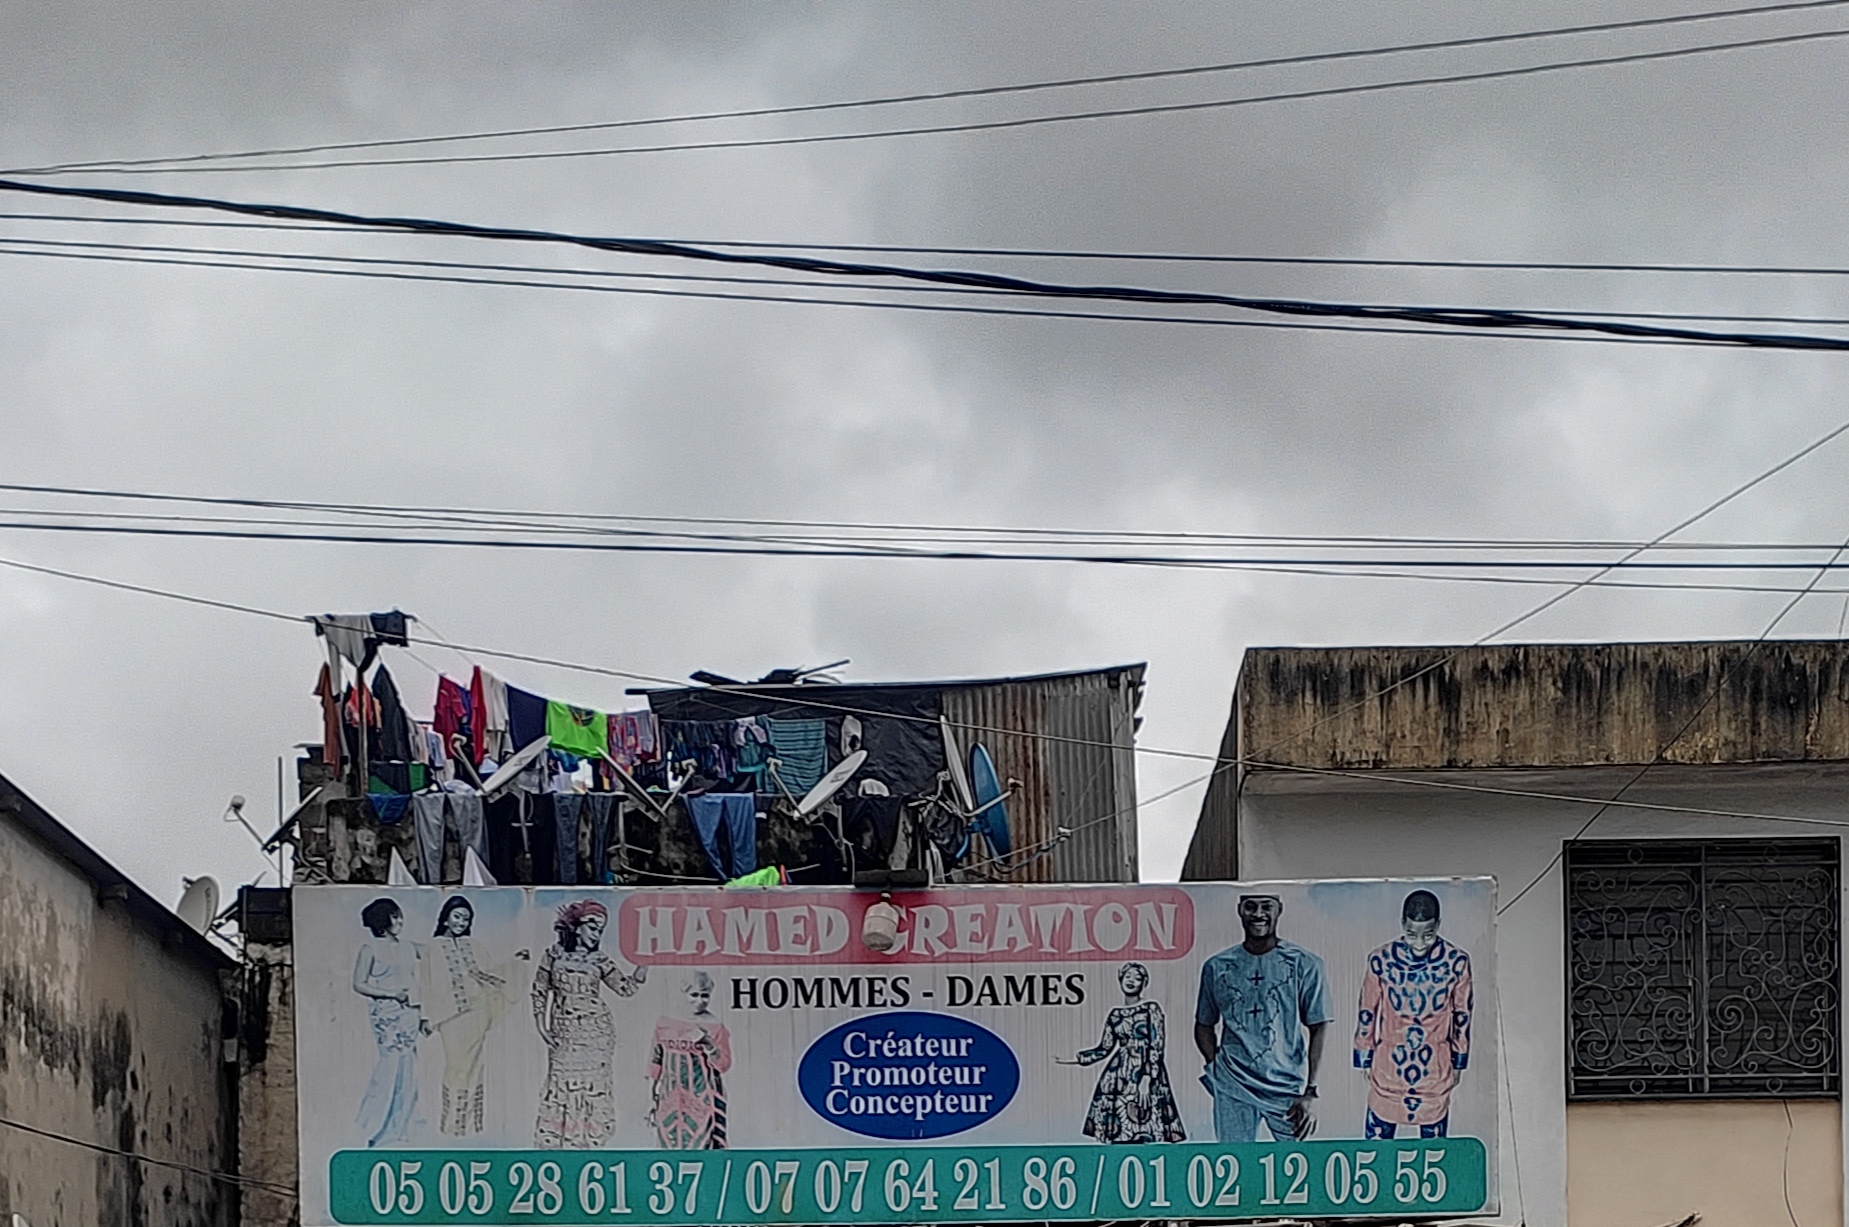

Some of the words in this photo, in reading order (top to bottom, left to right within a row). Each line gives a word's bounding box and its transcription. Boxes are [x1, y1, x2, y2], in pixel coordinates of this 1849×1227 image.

[634, 904, 850, 955] HAMED
[731, 976, 911, 1009] HOMMES
[946, 974, 1085, 1006] DAMES
[843, 1031, 973, 1058] Créateur
[830, 1061, 986, 1087] Promoteur
[825, 1089, 993, 1121] Concepteur
[369, 1161, 423, 1214] 05
[438, 1161, 494, 1214] 05
[508, 1161, 563, 1214] 28
[578, 1161, 632, 1214] 61
[648, 1161, 703, 1214] 37
[716, 1159, 732, 1220] /
[744, 1160, 799, 1213] 07
[814, 1160, 869, 1212] 07
[884, 1159, 938, 1212] 64
[953, 1158, 1005, 1210] 21
[1022, 1157, 1076, 1209] 86
[1090, 1154, 1105, 1214] /
[1118, 1156, 1170, 1208] 01
[1187, 1155, 1239, 1207] 02
[1259, 1153, 1308, 1206] 12
[1324, 1151, 1377, 1204] 05
[1394, 1149, 1447, 1202] 55
